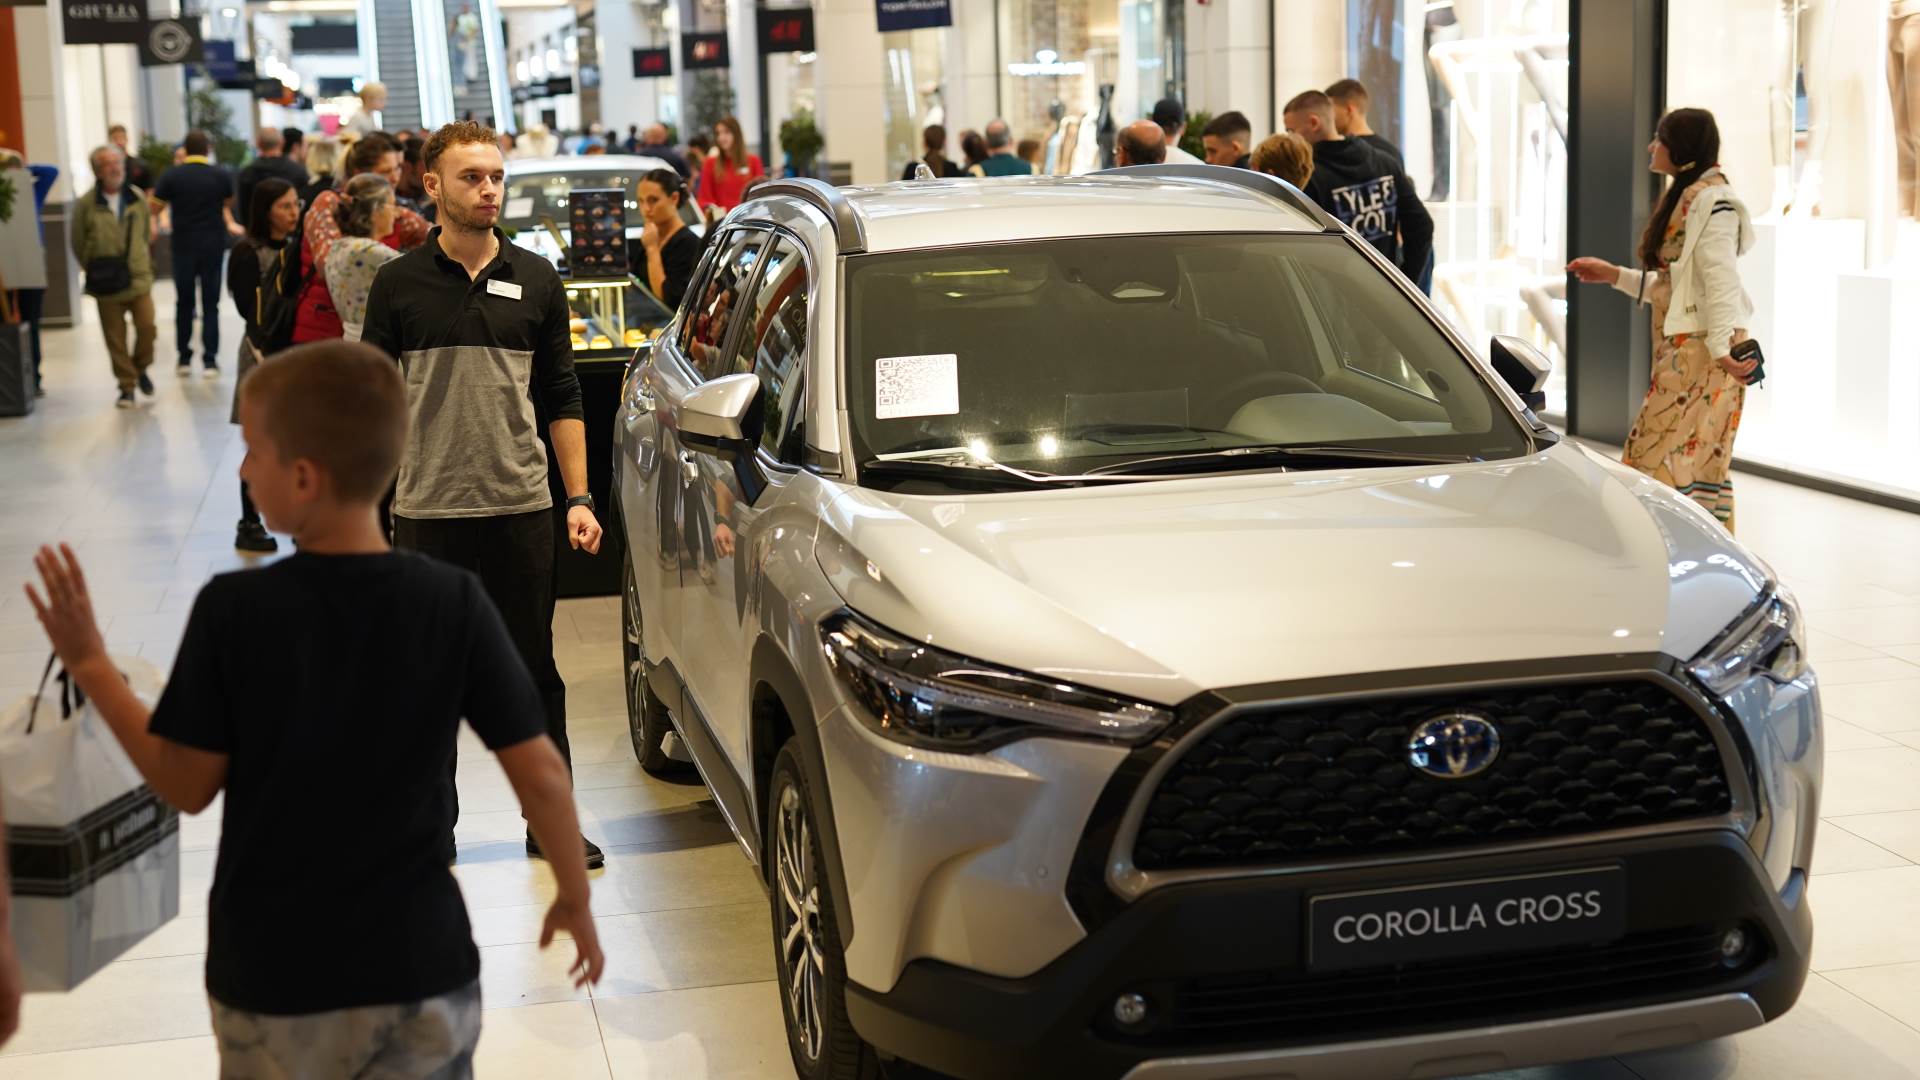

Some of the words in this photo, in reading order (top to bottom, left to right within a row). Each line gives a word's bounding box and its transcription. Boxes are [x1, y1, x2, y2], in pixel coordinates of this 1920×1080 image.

[68, 4, 140, 19] GIULIA
[1332, 183, 1384, 216] LYLE
[1343, 206, 1397, 236] COTT
[1333, 902, 1487, 944] COROLLA
[1495, 890, 1602, 926] CROSS
